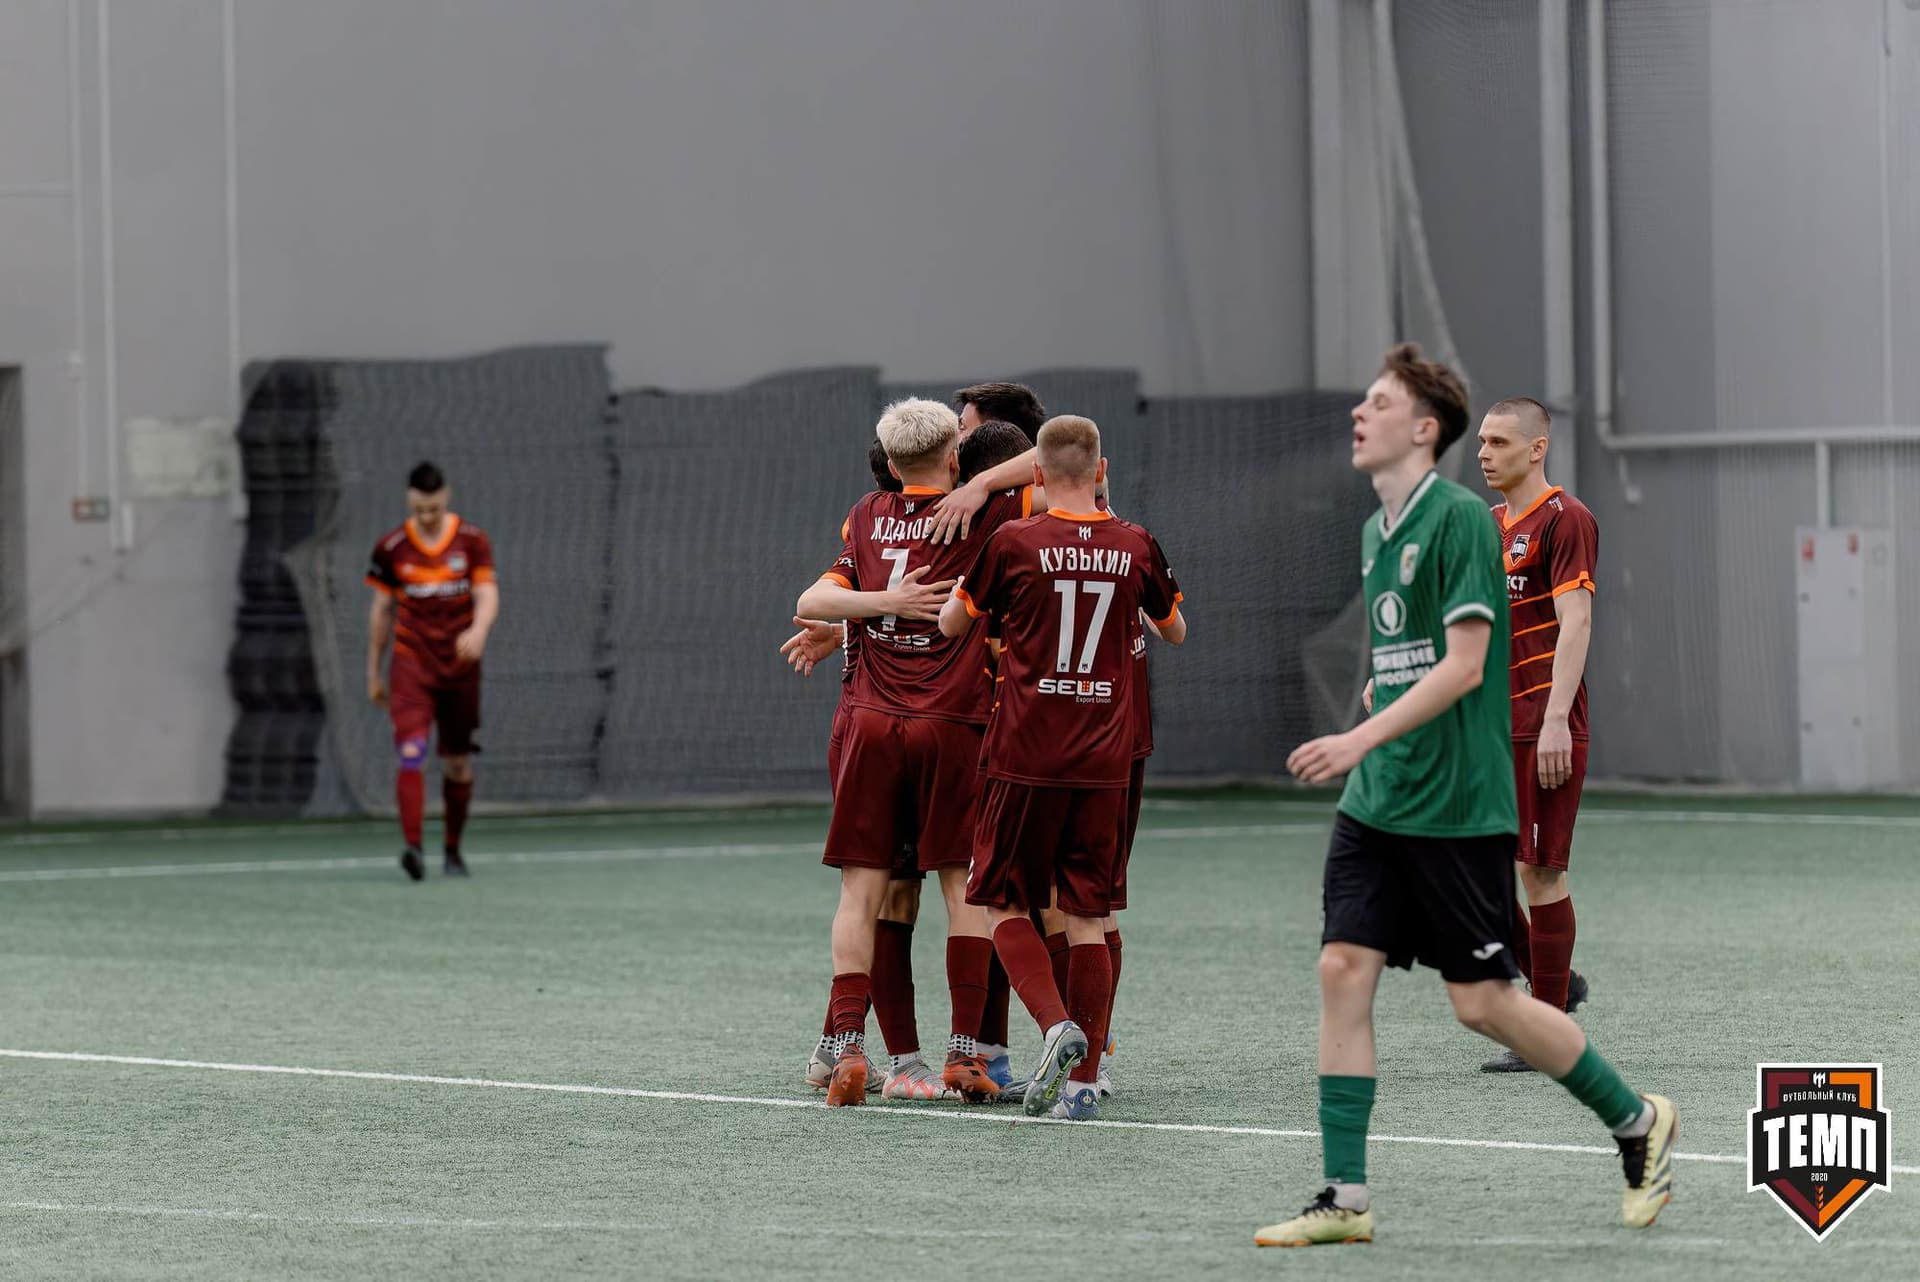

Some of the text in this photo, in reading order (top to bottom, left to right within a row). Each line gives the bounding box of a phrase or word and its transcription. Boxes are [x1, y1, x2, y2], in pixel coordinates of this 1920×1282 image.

[1038, 547, 1132, 577] КУЗЬКИН
[880, 548, 910, 631] 7
[1054, 579, 1116, 674] 17
[1037, 679, 1112, 697] SEUS
[1075, 696, 1112, 705] Export Union
